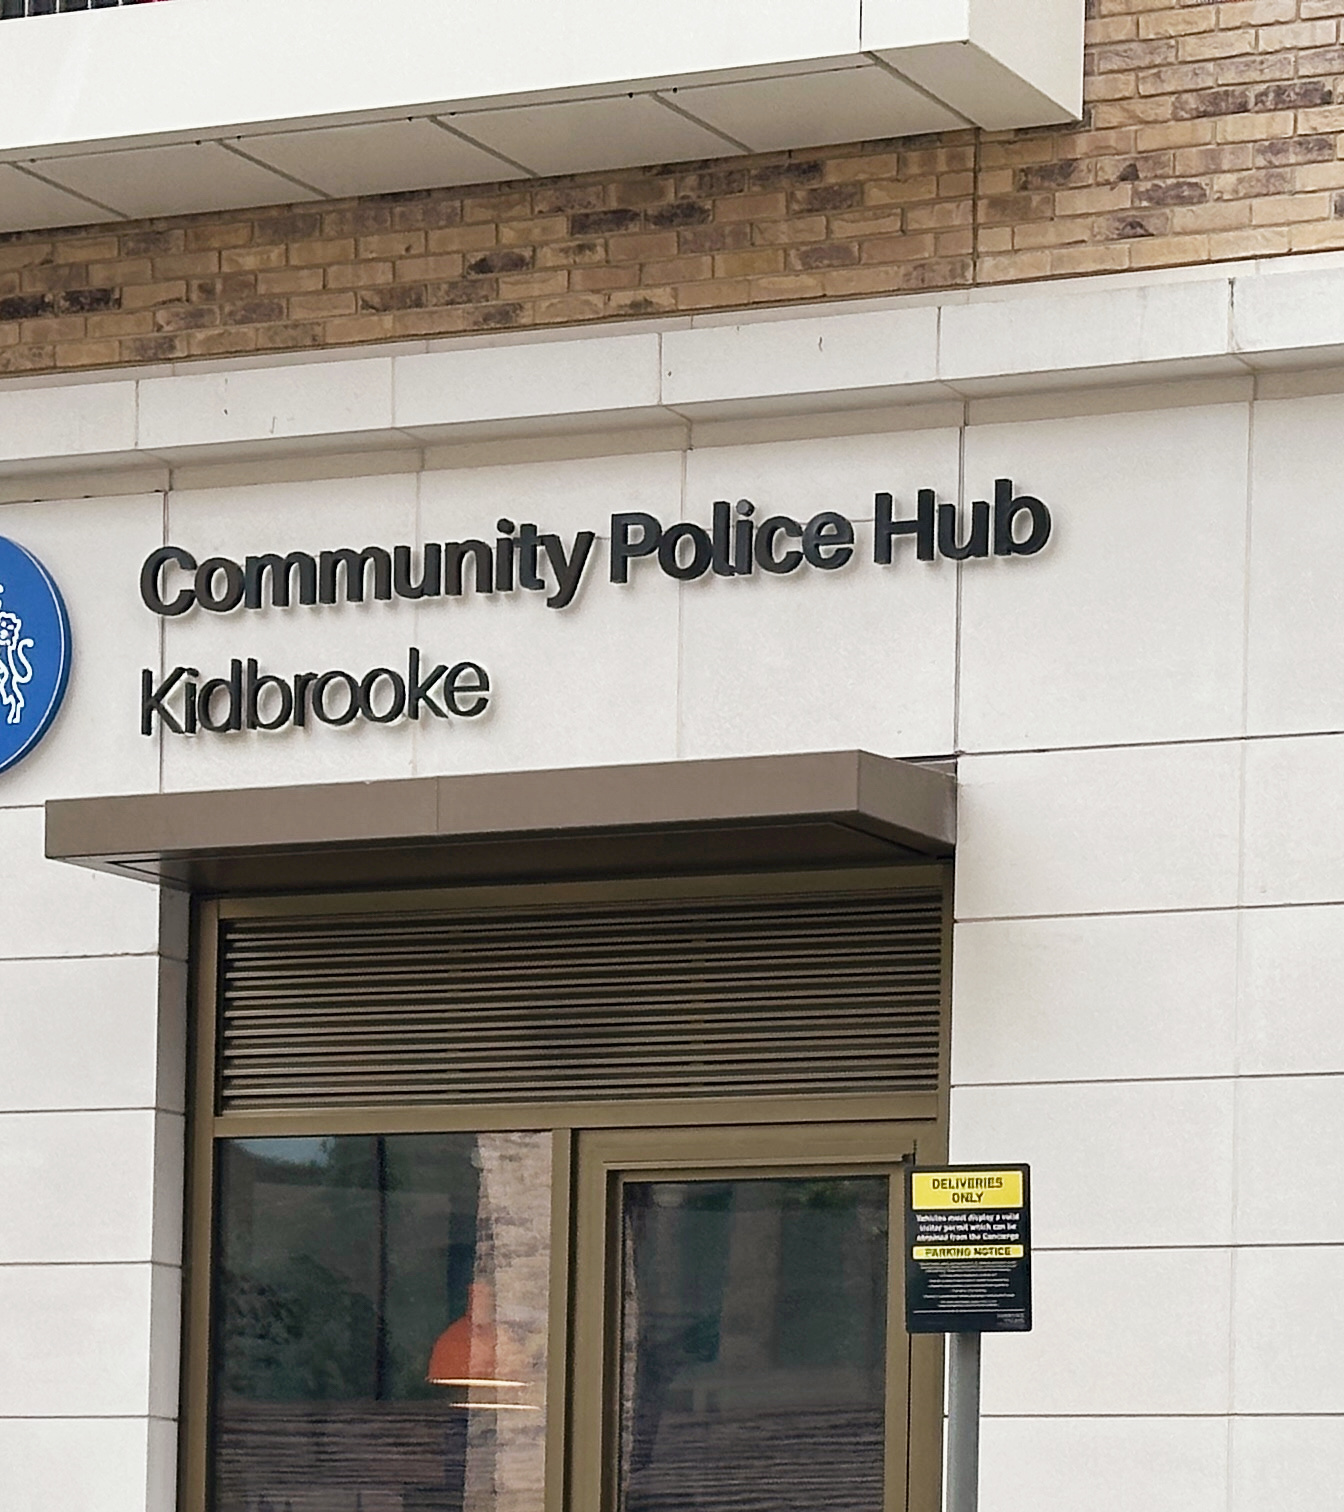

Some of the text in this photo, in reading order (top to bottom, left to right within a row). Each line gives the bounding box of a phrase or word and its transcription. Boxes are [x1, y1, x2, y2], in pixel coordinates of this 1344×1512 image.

[140, 477, 1052, 617] Community Police Hub
[140, 646, 491, 736] Kidbrooke
[932, 1177, 1003, 1190] DELIVERIES
[951, 1192, 984, 1204] ONLY
[925, 1246, 1012, 1258] PARKING NOTICE
